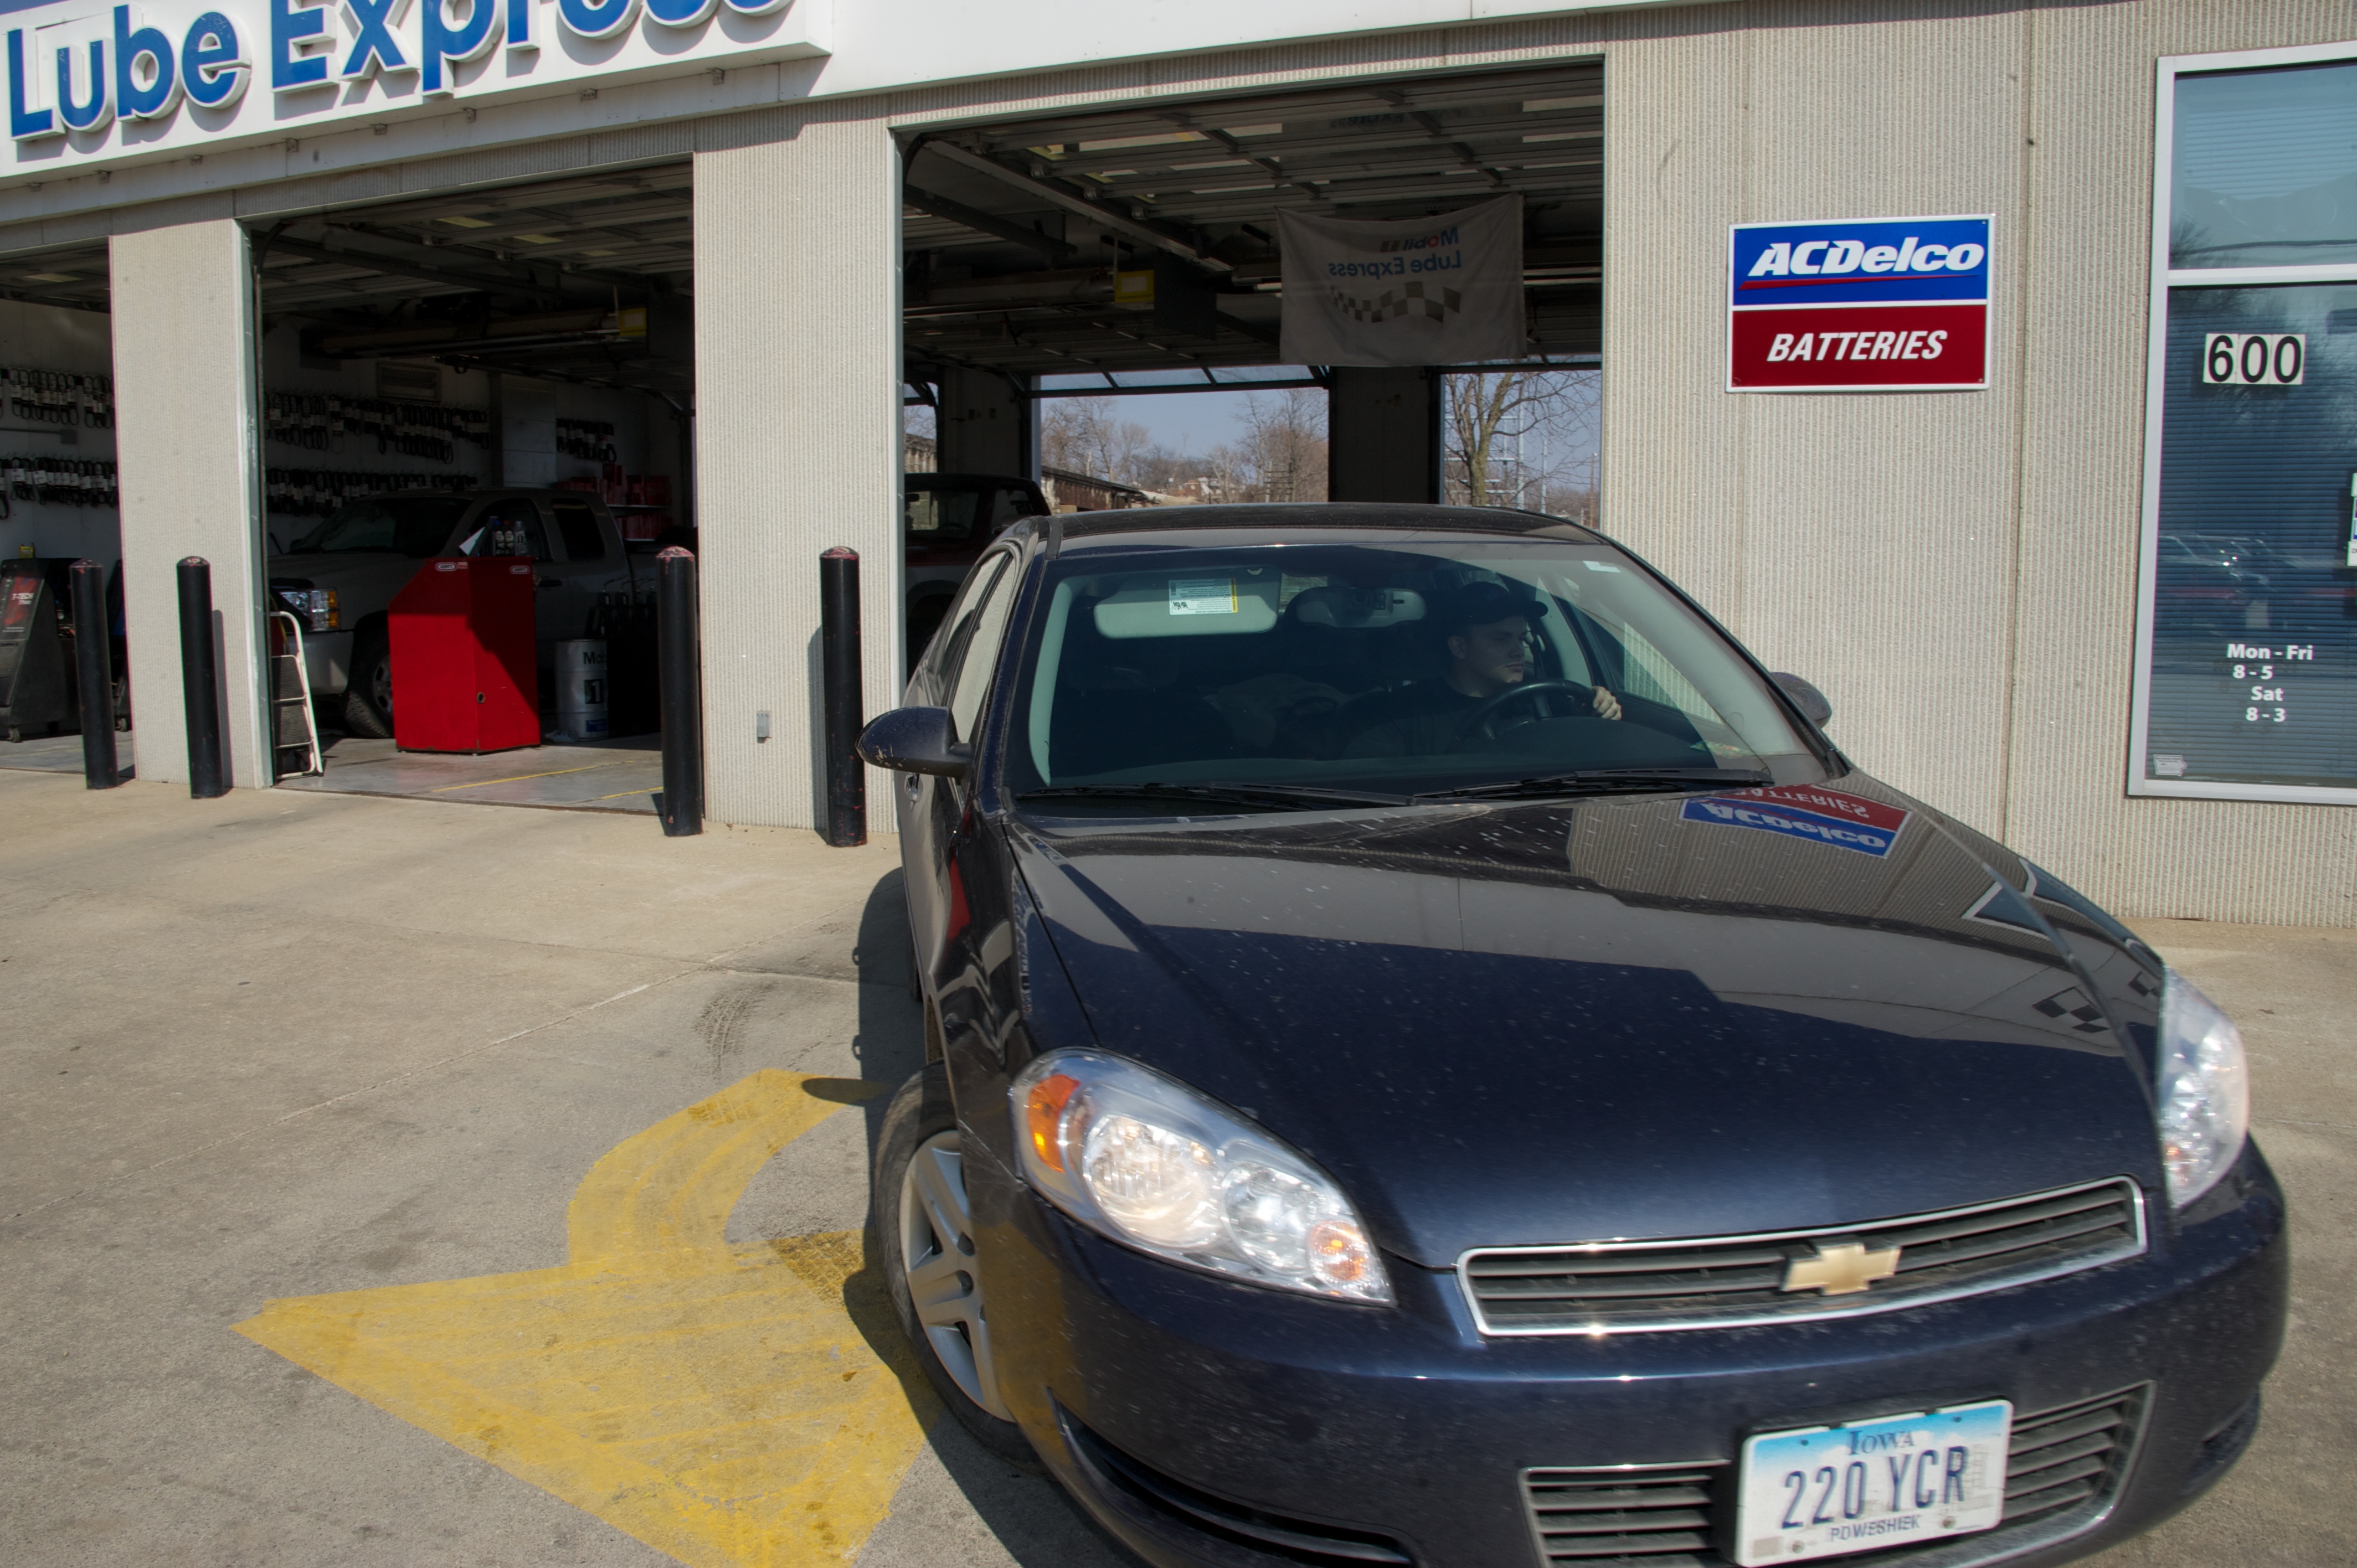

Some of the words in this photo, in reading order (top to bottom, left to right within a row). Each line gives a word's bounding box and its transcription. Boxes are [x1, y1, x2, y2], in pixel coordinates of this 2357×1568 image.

[8, 4, 241, 138] Lube
[271, 0, 788, 94] Expr
[1747, 237, 1985, 276] ACDelco
[1767, 330, 1948, 362] BATTERIES
[2209, 335, 2302, 383] 600
[2226, 643, 2271, 659] Mon
[2286, 645, 2314, 661] Fri
[2232, 664, 2246, 679] 8
[2260, 666, 2274, 680] 5
[2251, 685, 2284, 702] Sat
[2245, 706, 2259, 721] 8
[2273, 708, 2286, 723] 3
[1782, 1461, 1868, 1530] 220
[1888, 1445, 1971, 1513] YCR
[1830, 1514, 1923, 1543] POWESHIEK
